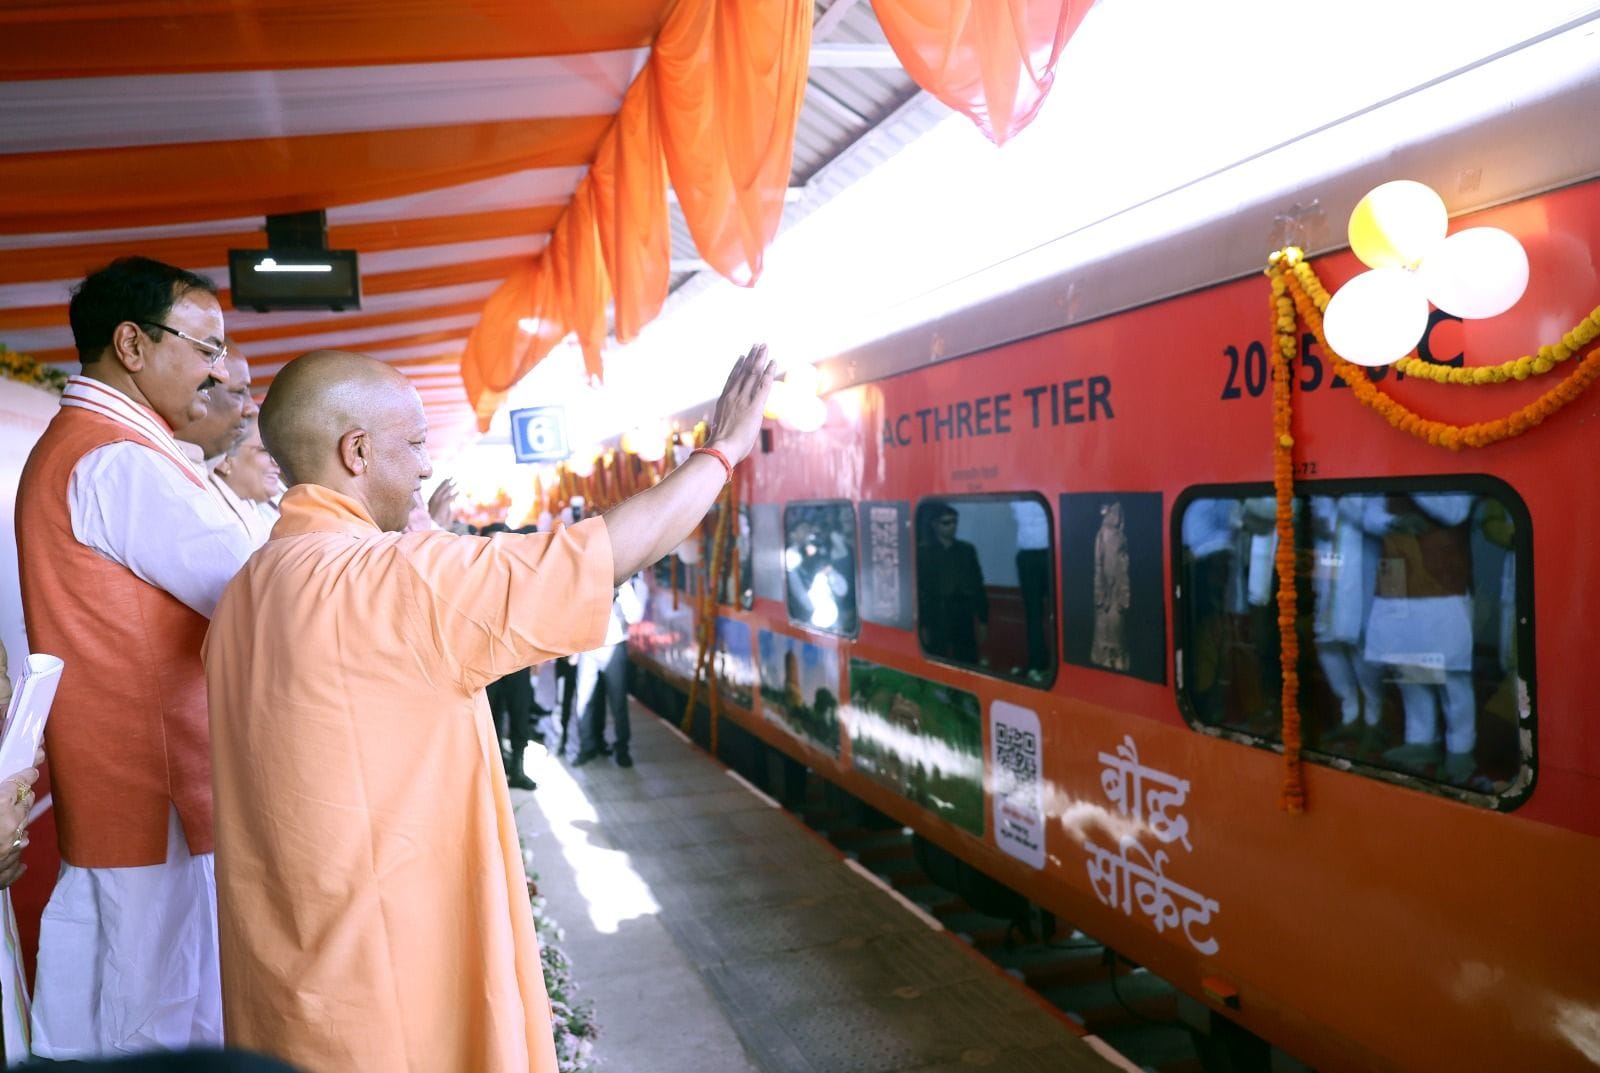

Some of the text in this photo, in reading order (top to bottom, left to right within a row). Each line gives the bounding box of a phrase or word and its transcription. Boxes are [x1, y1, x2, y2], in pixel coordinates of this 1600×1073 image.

[526, 416, 555, 452] 6
[882, 375, 1114, 448] AC THREE TIER
[1098, 735, 1193, 853] बौद्ध
[1084, 834, 1220, 956] सर्किट
